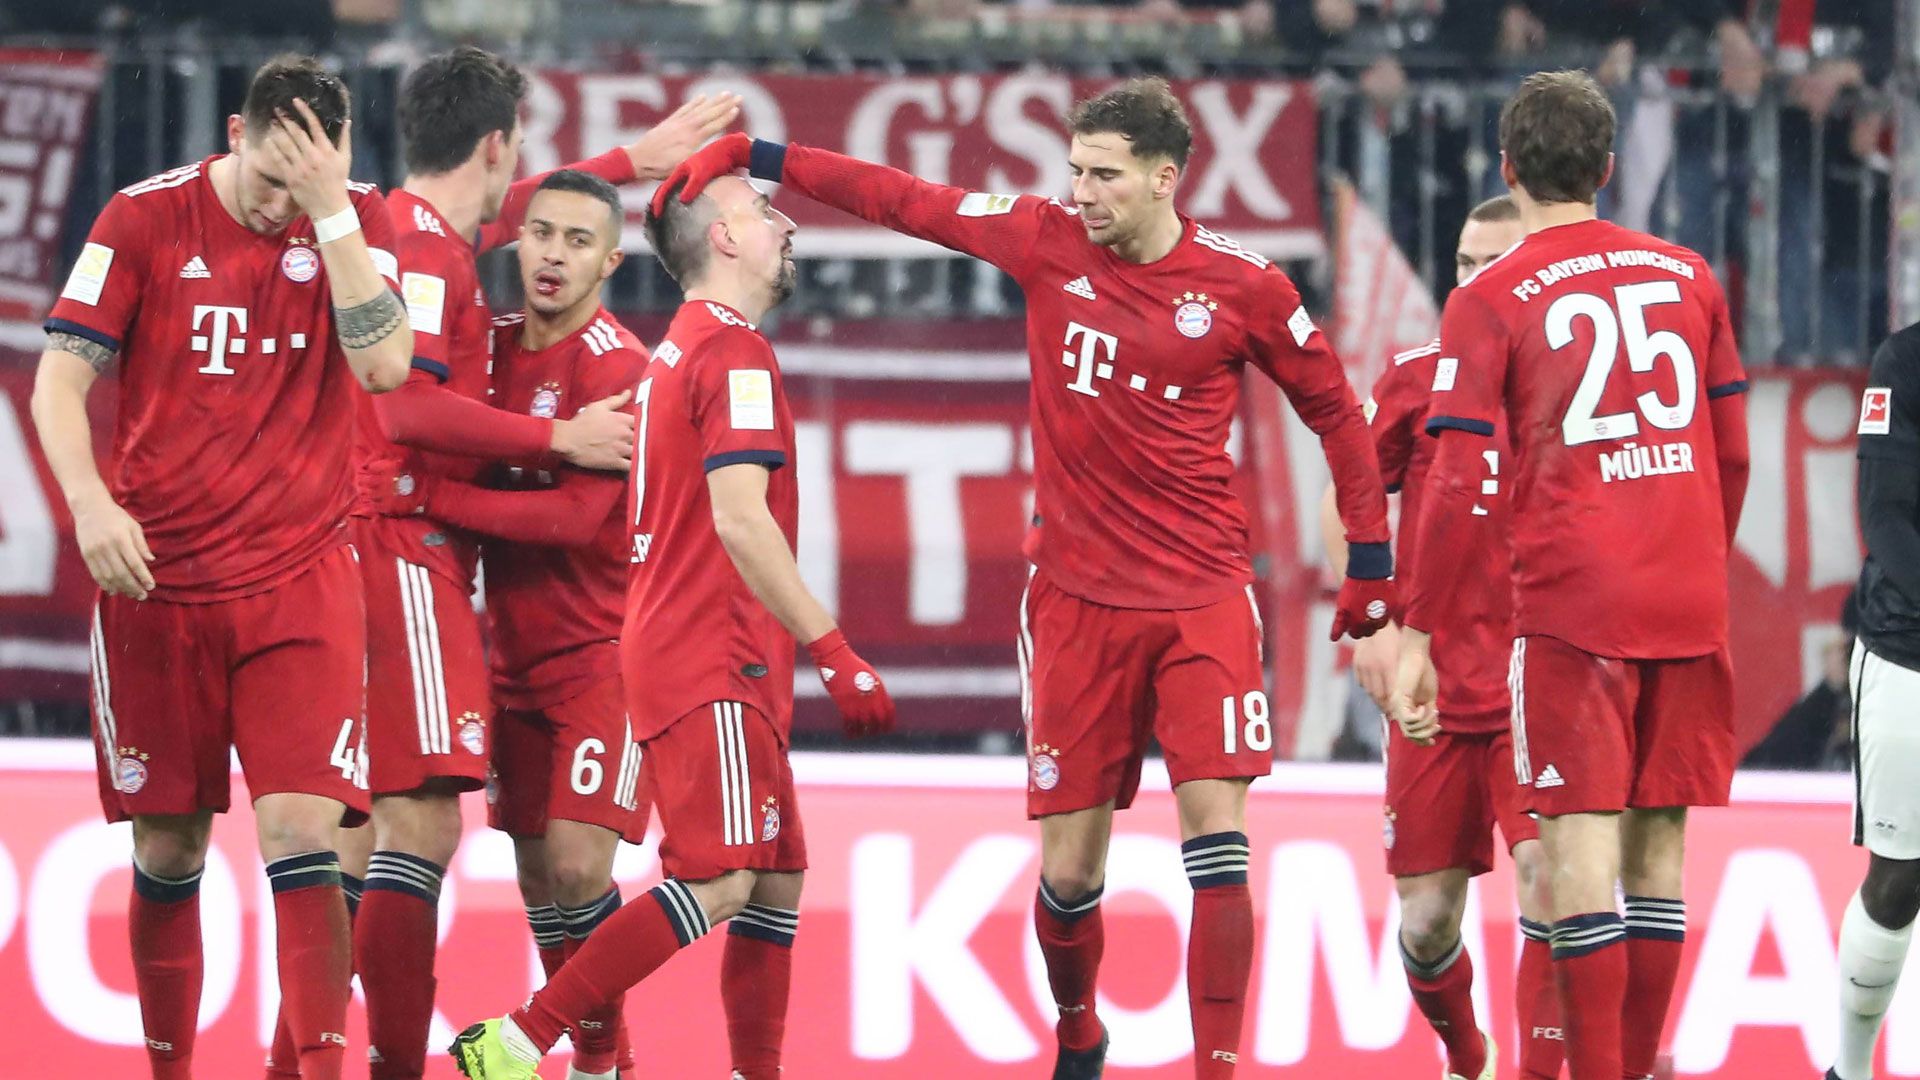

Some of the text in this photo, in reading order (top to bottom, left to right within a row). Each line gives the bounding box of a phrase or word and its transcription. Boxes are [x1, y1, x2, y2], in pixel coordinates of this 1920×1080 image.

[1512, 279, 1542, 302] FC
[1535, 253, 1607, 287] BAYERN
[1544, 280, 1698, 447] 25
[1599, 442, 1695, 483] MÜLLER
[329, 718, 356, 780] 4
[1222, 689, 1273, 755] 18
[570, 737, 607, 796] 6
